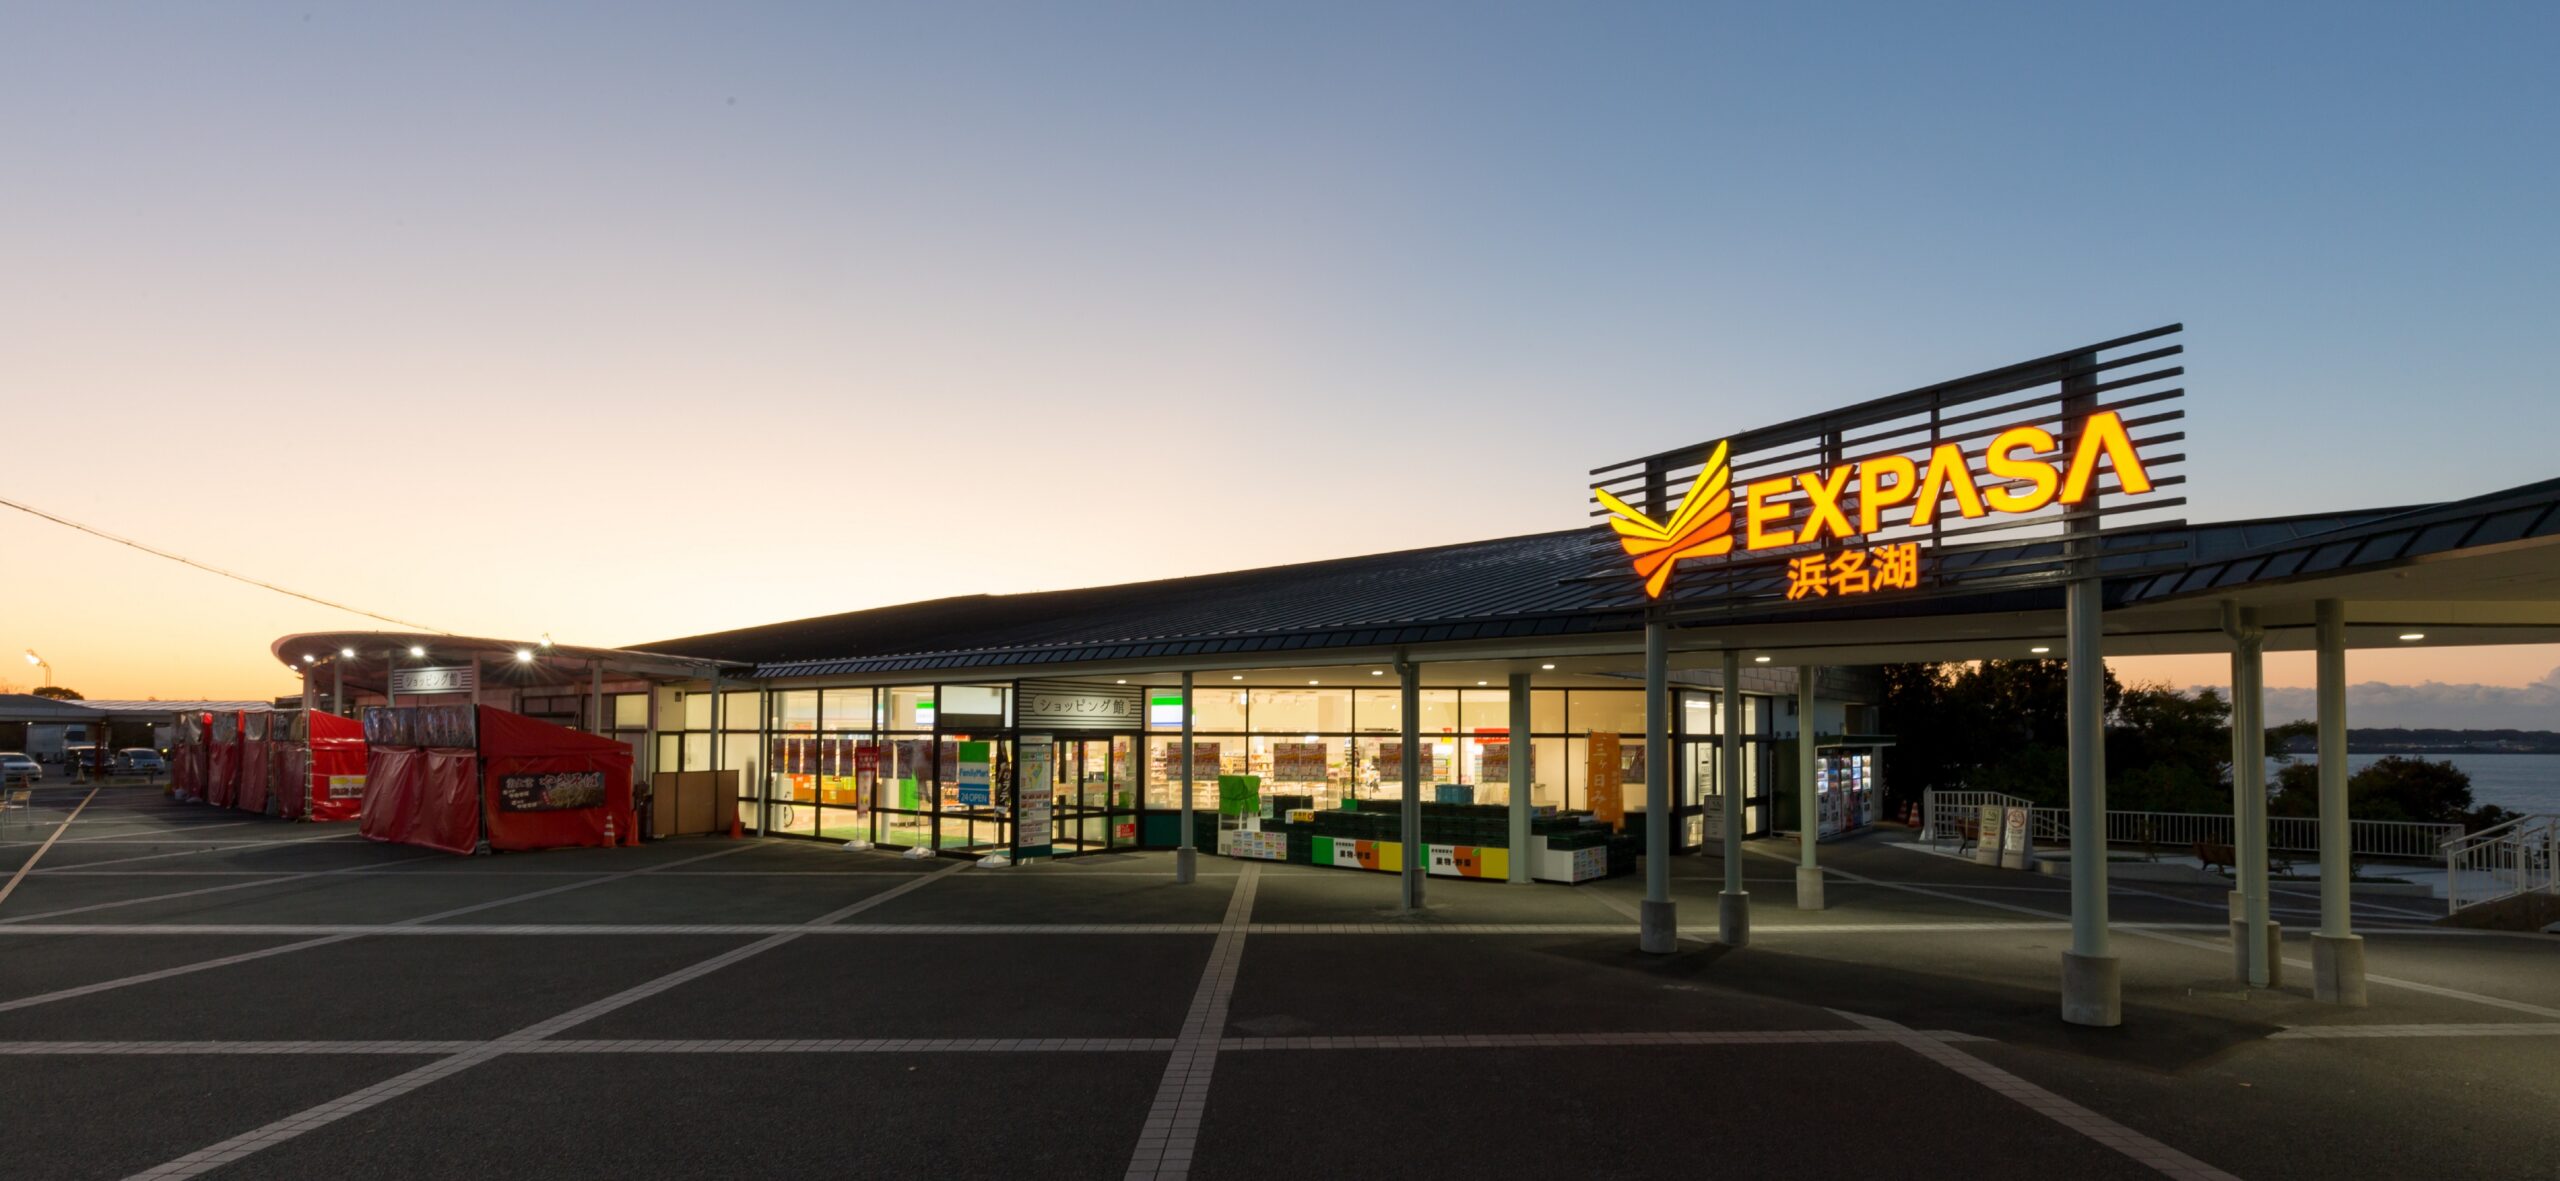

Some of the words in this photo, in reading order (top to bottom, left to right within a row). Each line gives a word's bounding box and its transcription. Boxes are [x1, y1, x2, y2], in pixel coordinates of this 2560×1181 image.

[1746, 410, 2153, 551] EXPASA
[1786, 542, 1920, 601] 浜名湖
[406, 672, 458, 687] ショッピング館
[1040, 698, 1125, 715] ショッピング館
